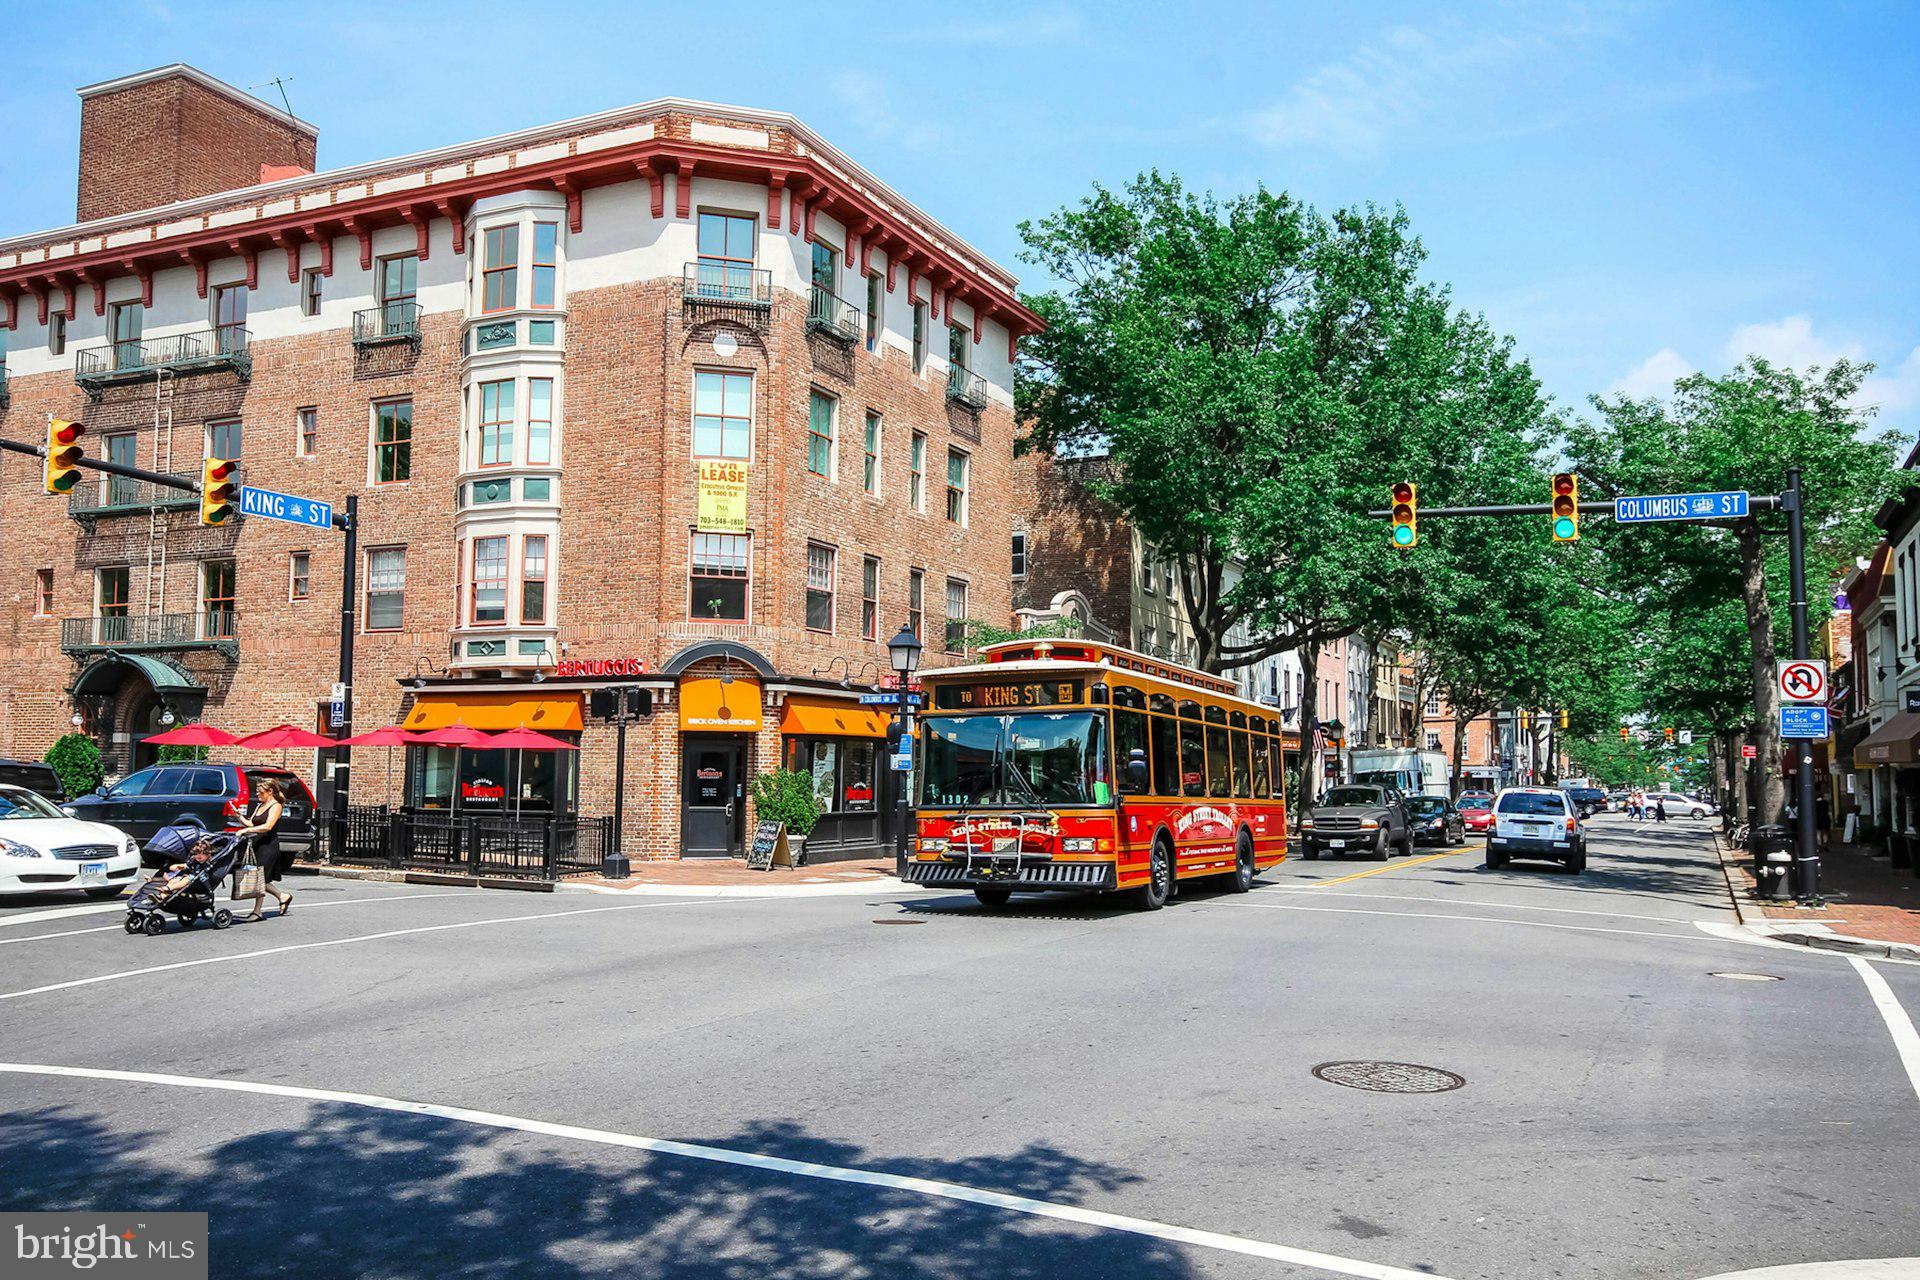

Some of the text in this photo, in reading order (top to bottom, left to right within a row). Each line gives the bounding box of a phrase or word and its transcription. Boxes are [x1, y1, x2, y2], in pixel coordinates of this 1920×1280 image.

[701, 468, 745, 483] LEASE
[245, 490, 329, 525] KING ST
[1619, 495, 1741, 519] COLUMBUS ST
[557, 658, 643, 677] BERTUCCI'S
[960, 691, 972, 703] TO
[984, 686, 1019, 706] KING
[1024, 685, 1041, 705] ST
[942, 794, 969, 804] 1302
[977, 821, 1013, 832] STREET
